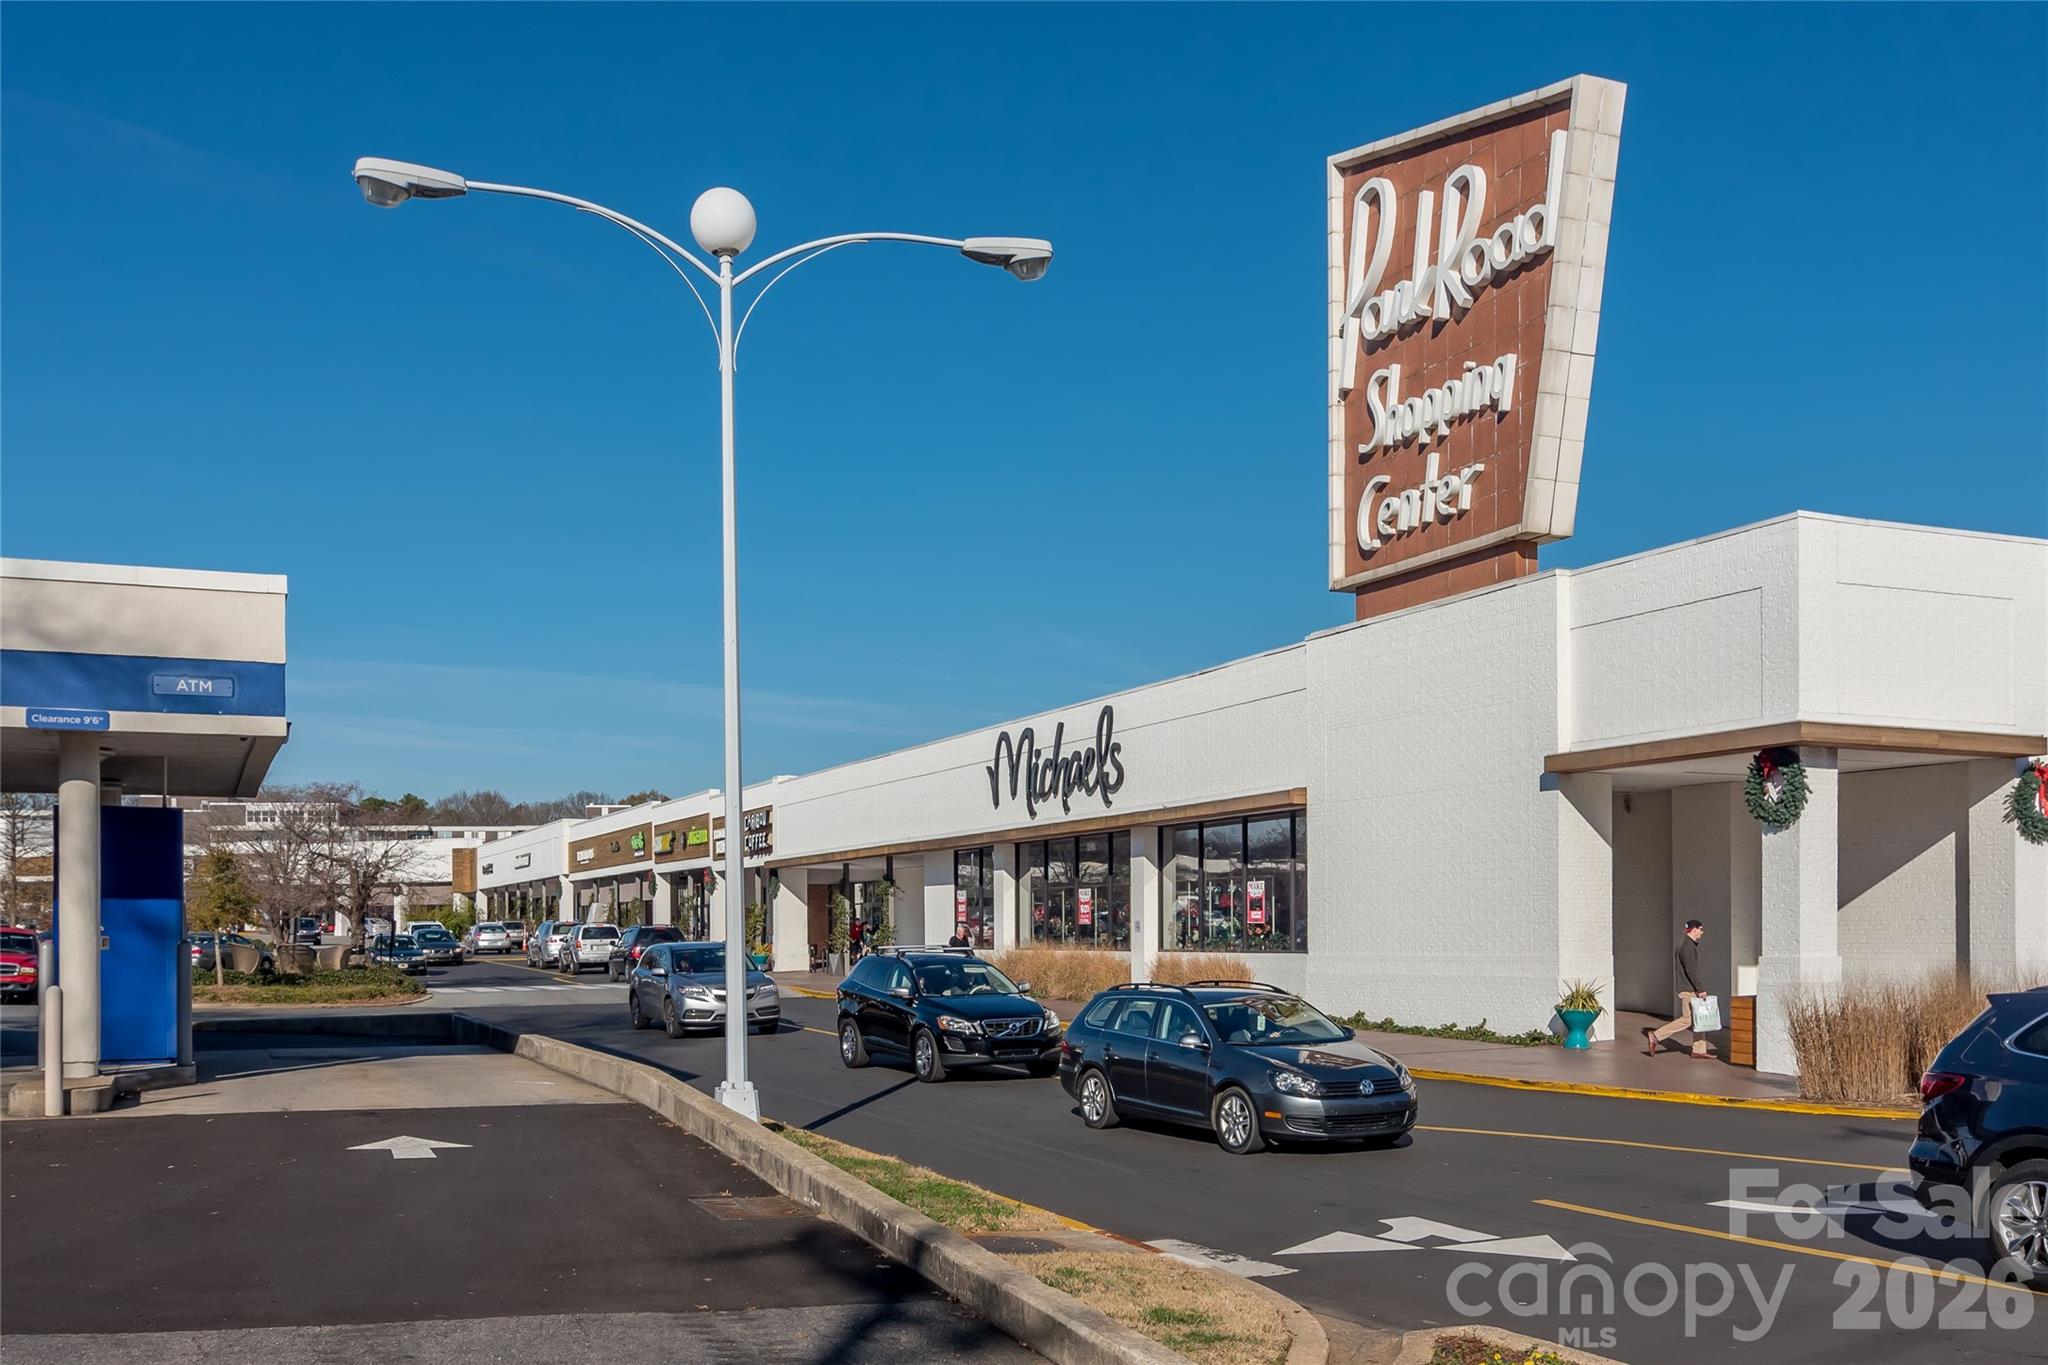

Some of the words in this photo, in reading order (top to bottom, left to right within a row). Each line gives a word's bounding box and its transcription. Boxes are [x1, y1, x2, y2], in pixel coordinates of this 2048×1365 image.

[1433, 128, 1567, 321] Road
[1358, 353, 1516, 454] Shopping
[1357, 452, 1484, 551] Center
[31, 713, 81, 724] Clearance
[175, 679, 213, 693] ATM
[985, 704, 1125, 820] Michaels
